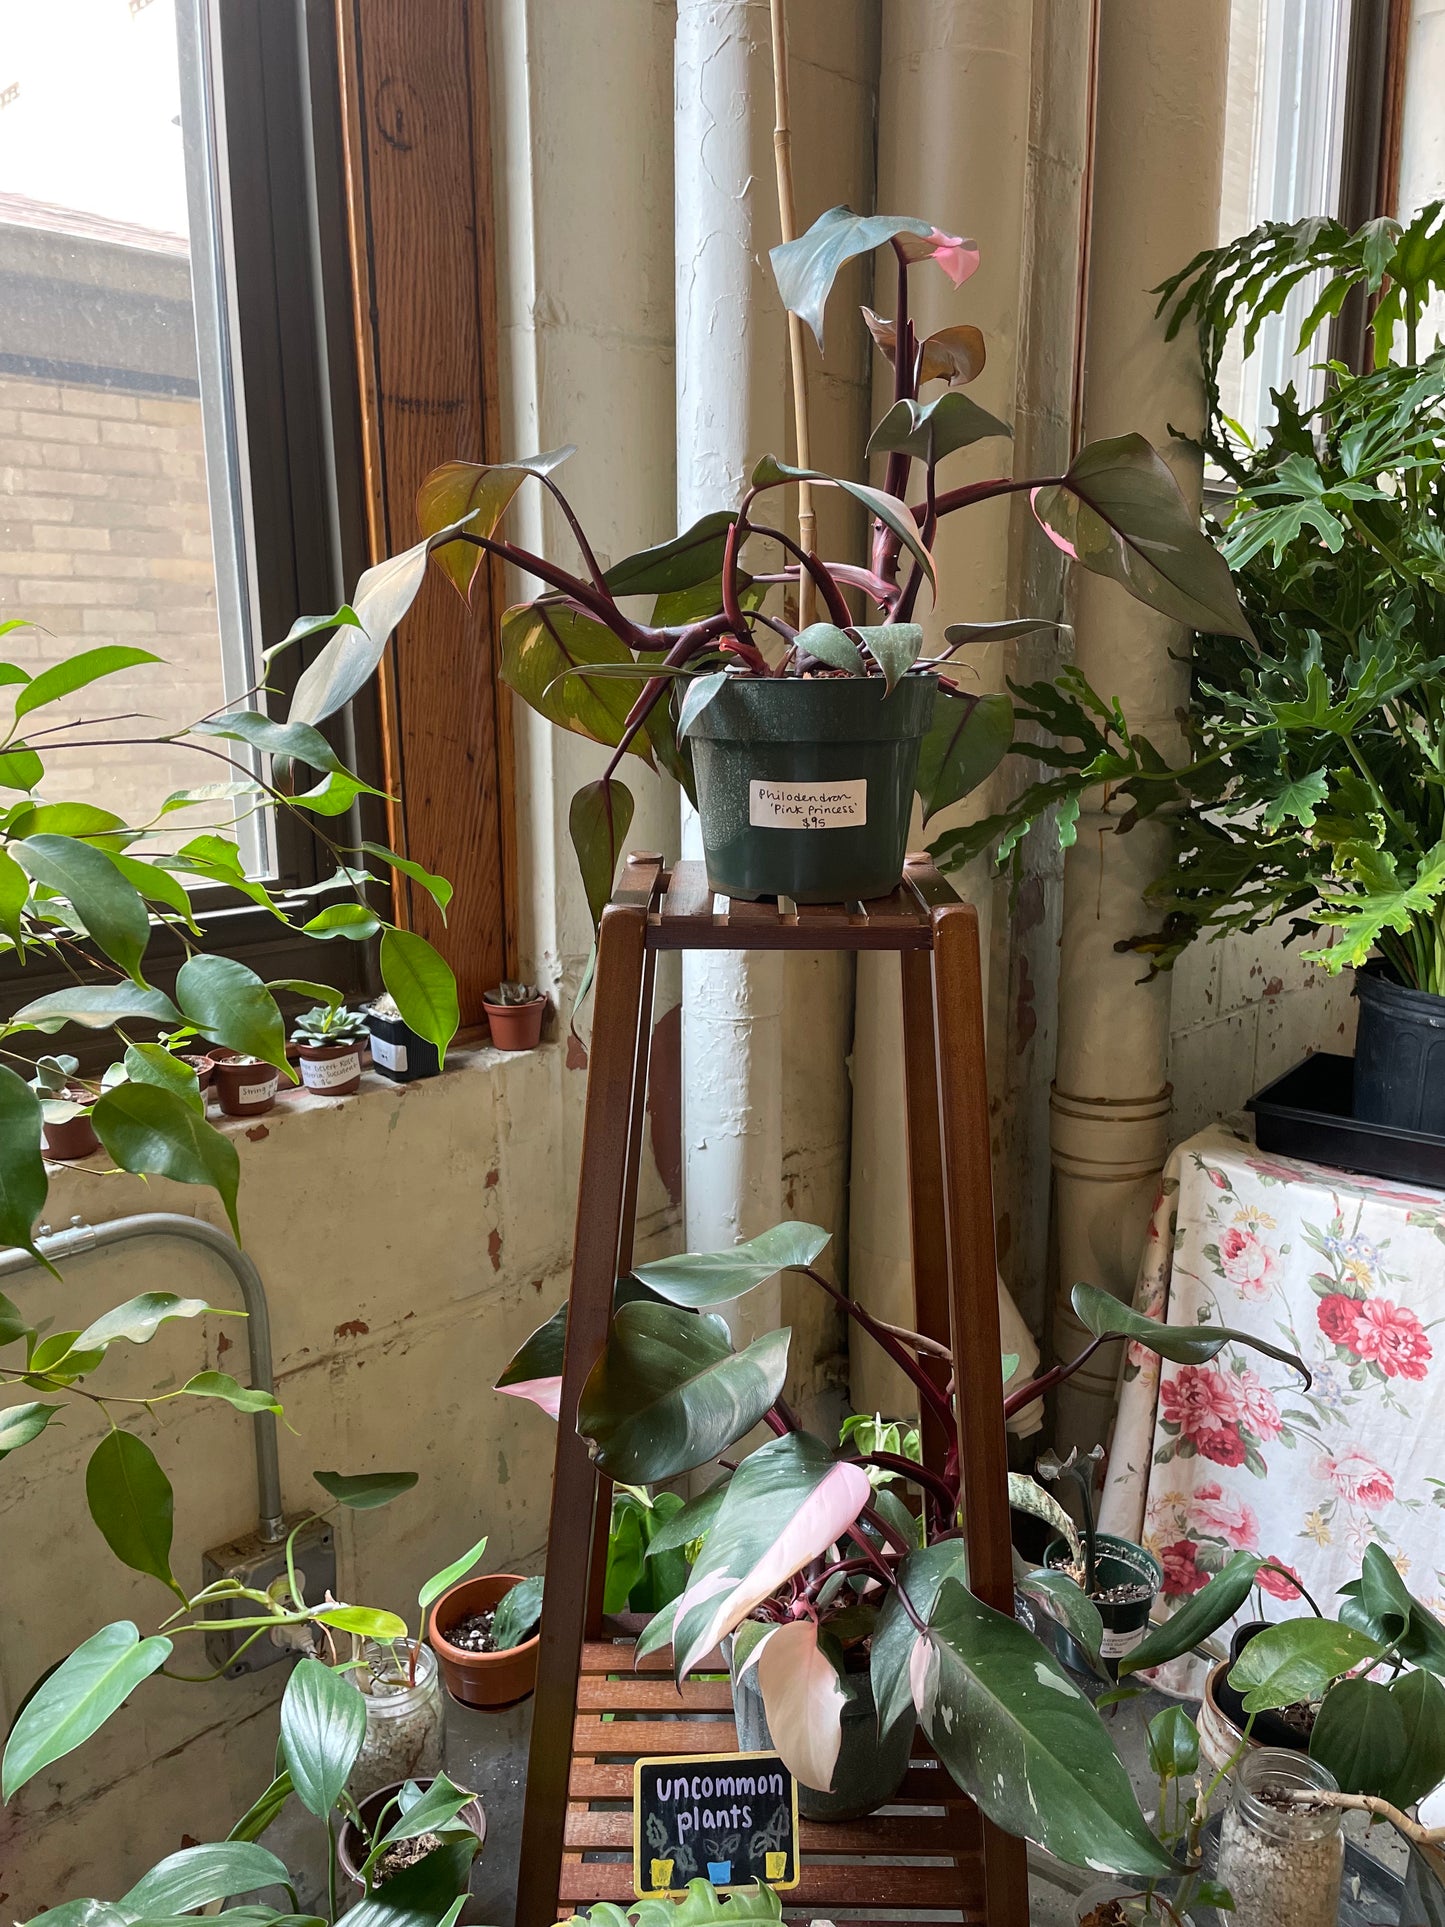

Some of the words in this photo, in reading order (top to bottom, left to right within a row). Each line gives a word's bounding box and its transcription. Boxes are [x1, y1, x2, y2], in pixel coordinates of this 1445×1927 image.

[759, 788, 851, 802] Philodendron
[802, 816, 826, 829] $95
[656, 1773, 783, 1801] uncommon
[677, 1804, 753, 1845] plants
